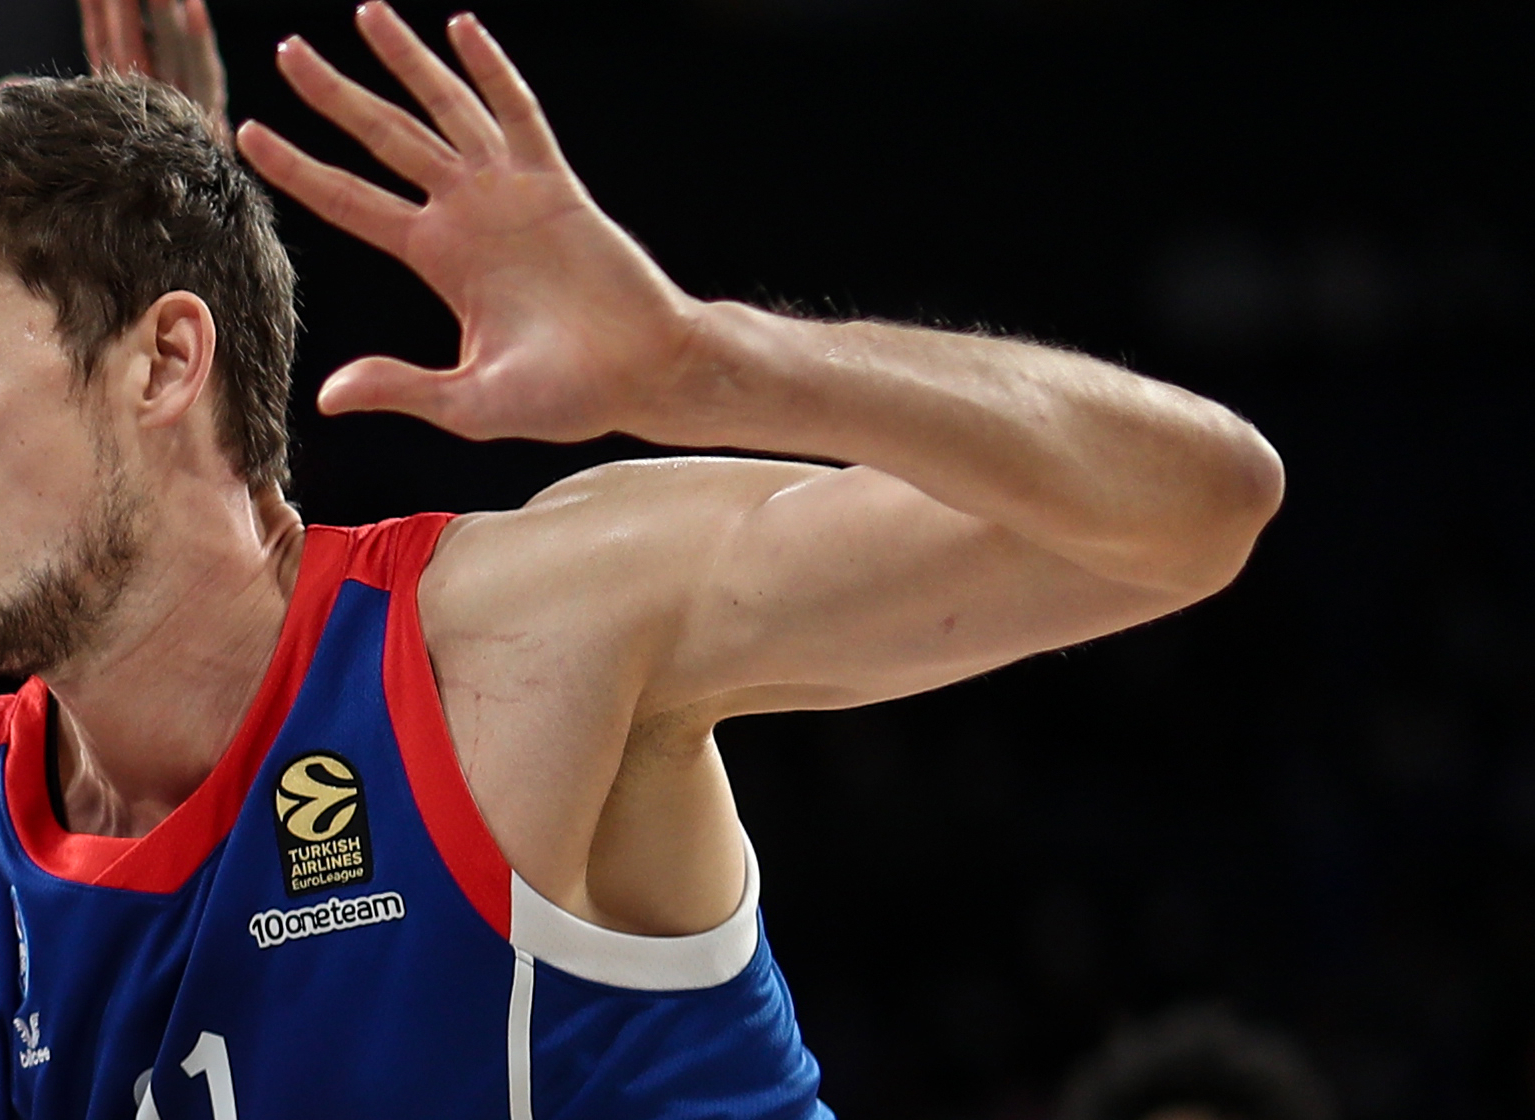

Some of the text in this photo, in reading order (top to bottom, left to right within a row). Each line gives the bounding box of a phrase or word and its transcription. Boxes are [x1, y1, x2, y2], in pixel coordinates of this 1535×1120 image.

[288, 836, 361, 863] TURKISH
[291, 851, 363, 878] AIRLINES
[292, 867, 365, 891] EuroLeague
